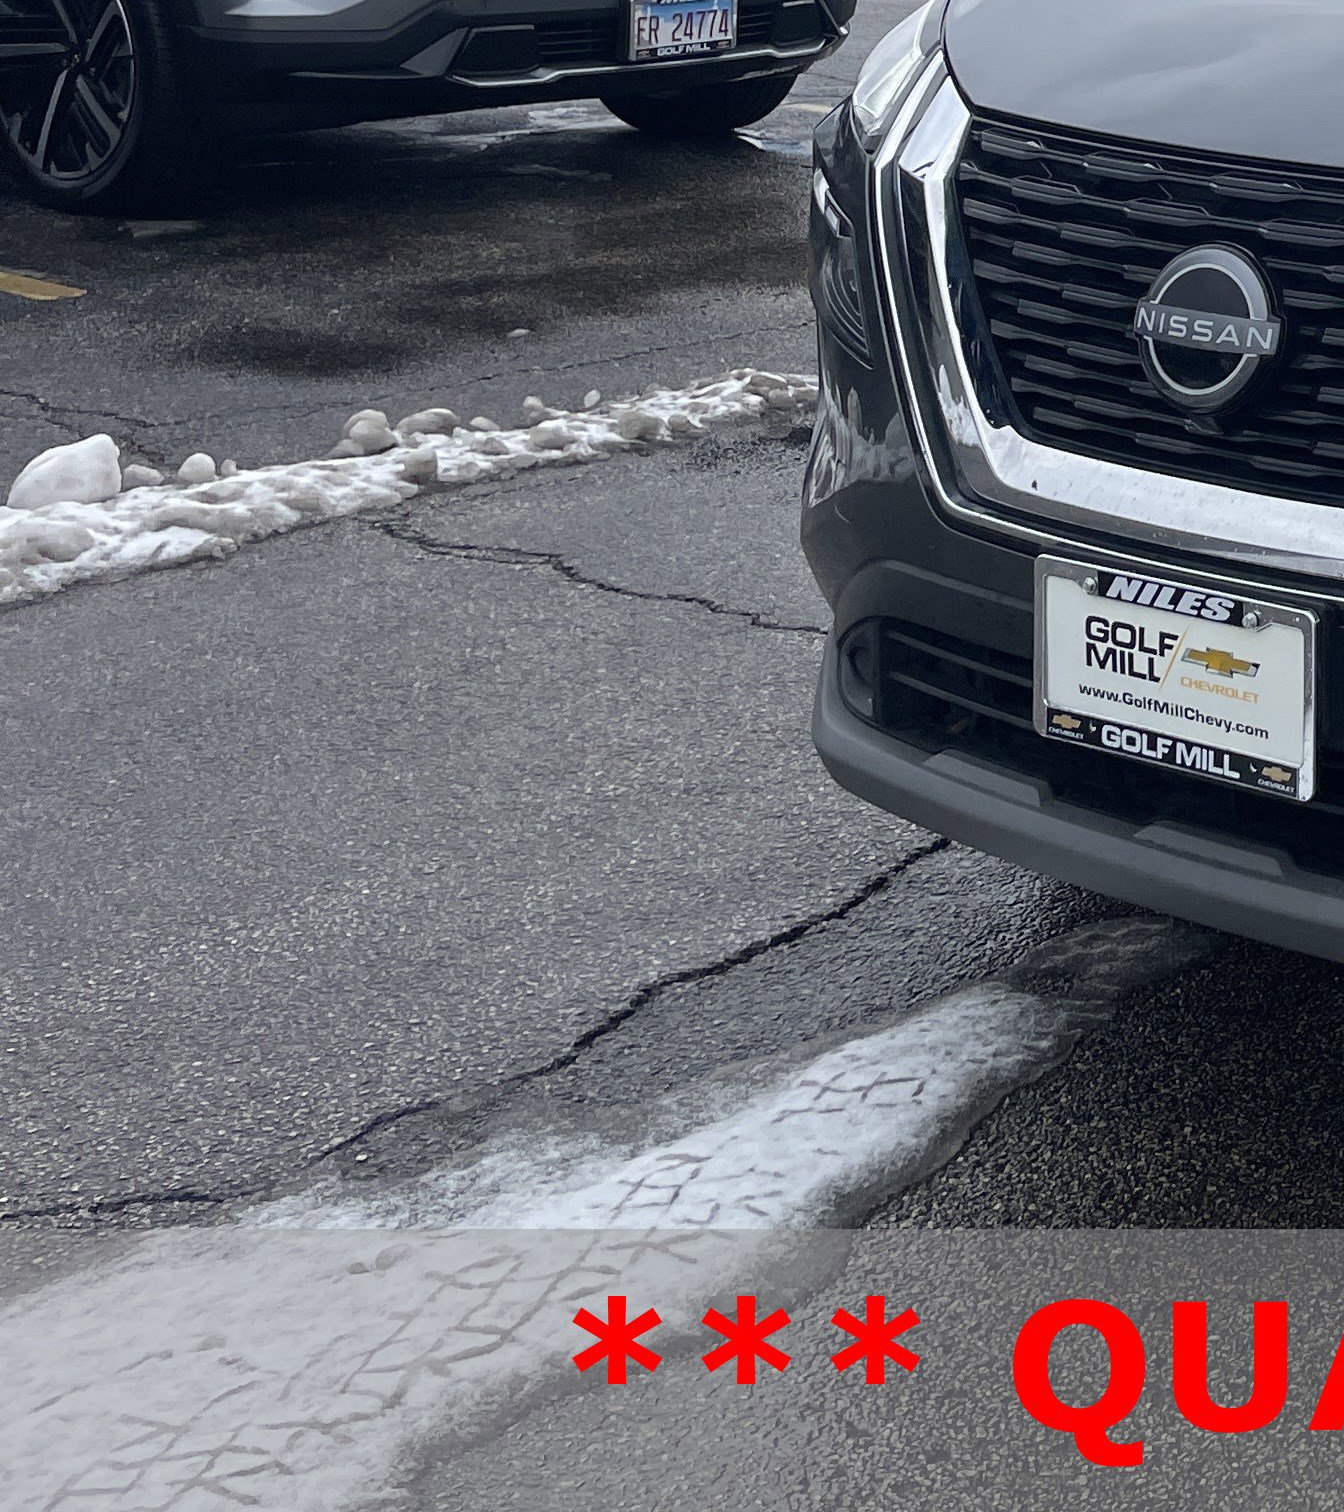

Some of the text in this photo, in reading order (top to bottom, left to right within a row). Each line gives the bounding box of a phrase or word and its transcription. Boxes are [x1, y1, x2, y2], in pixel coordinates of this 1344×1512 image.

[671, 8, 729, 43] 24774
[657, 45, 684, 56] GOLF
[686, 43, 710, 54] MILL
[1136, 306, 1273, 351] NISSAN
[1104, 575, 1236, 623] NILES
[1085, 615, 1180, 656] GOLF
[1085, 642, 1163, 684] MILL
[1078, 683, 1270, 740] www.GolfMillChevy.com
[1180, 676, 1260, 705] CHEVROLET
[1101, 724, 1241, 780] GOLF MILL
